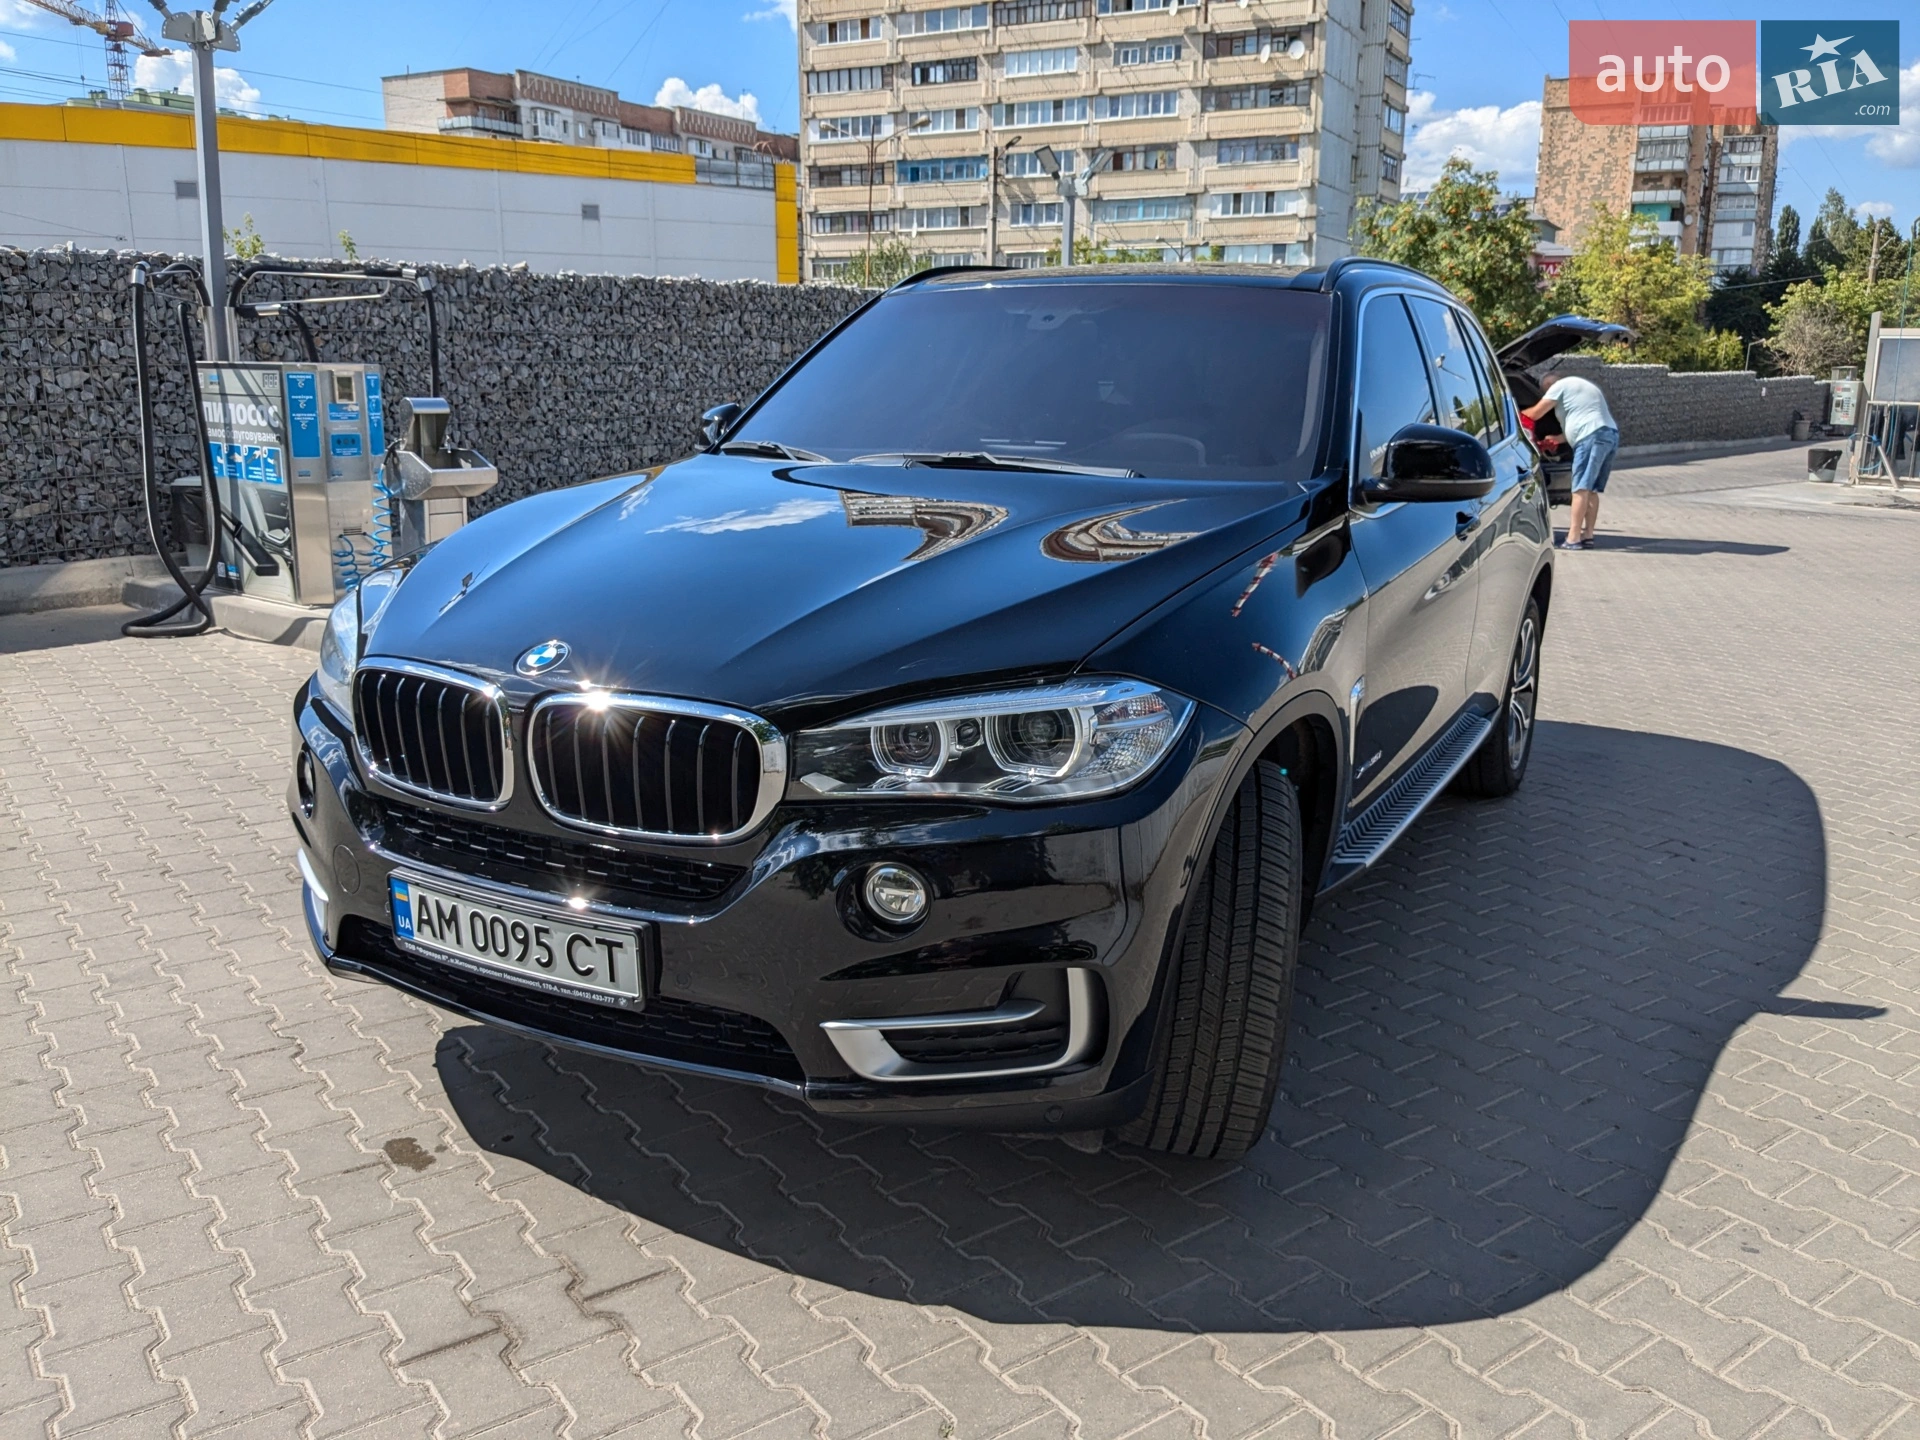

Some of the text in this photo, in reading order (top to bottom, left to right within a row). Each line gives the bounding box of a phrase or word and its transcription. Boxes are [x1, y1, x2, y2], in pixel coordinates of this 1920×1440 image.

[206, 426, 281, 444] амообслуговуванн
[397, 914, 413, 931] UA
[417, 893, 623, 983] AM 0095 CT
